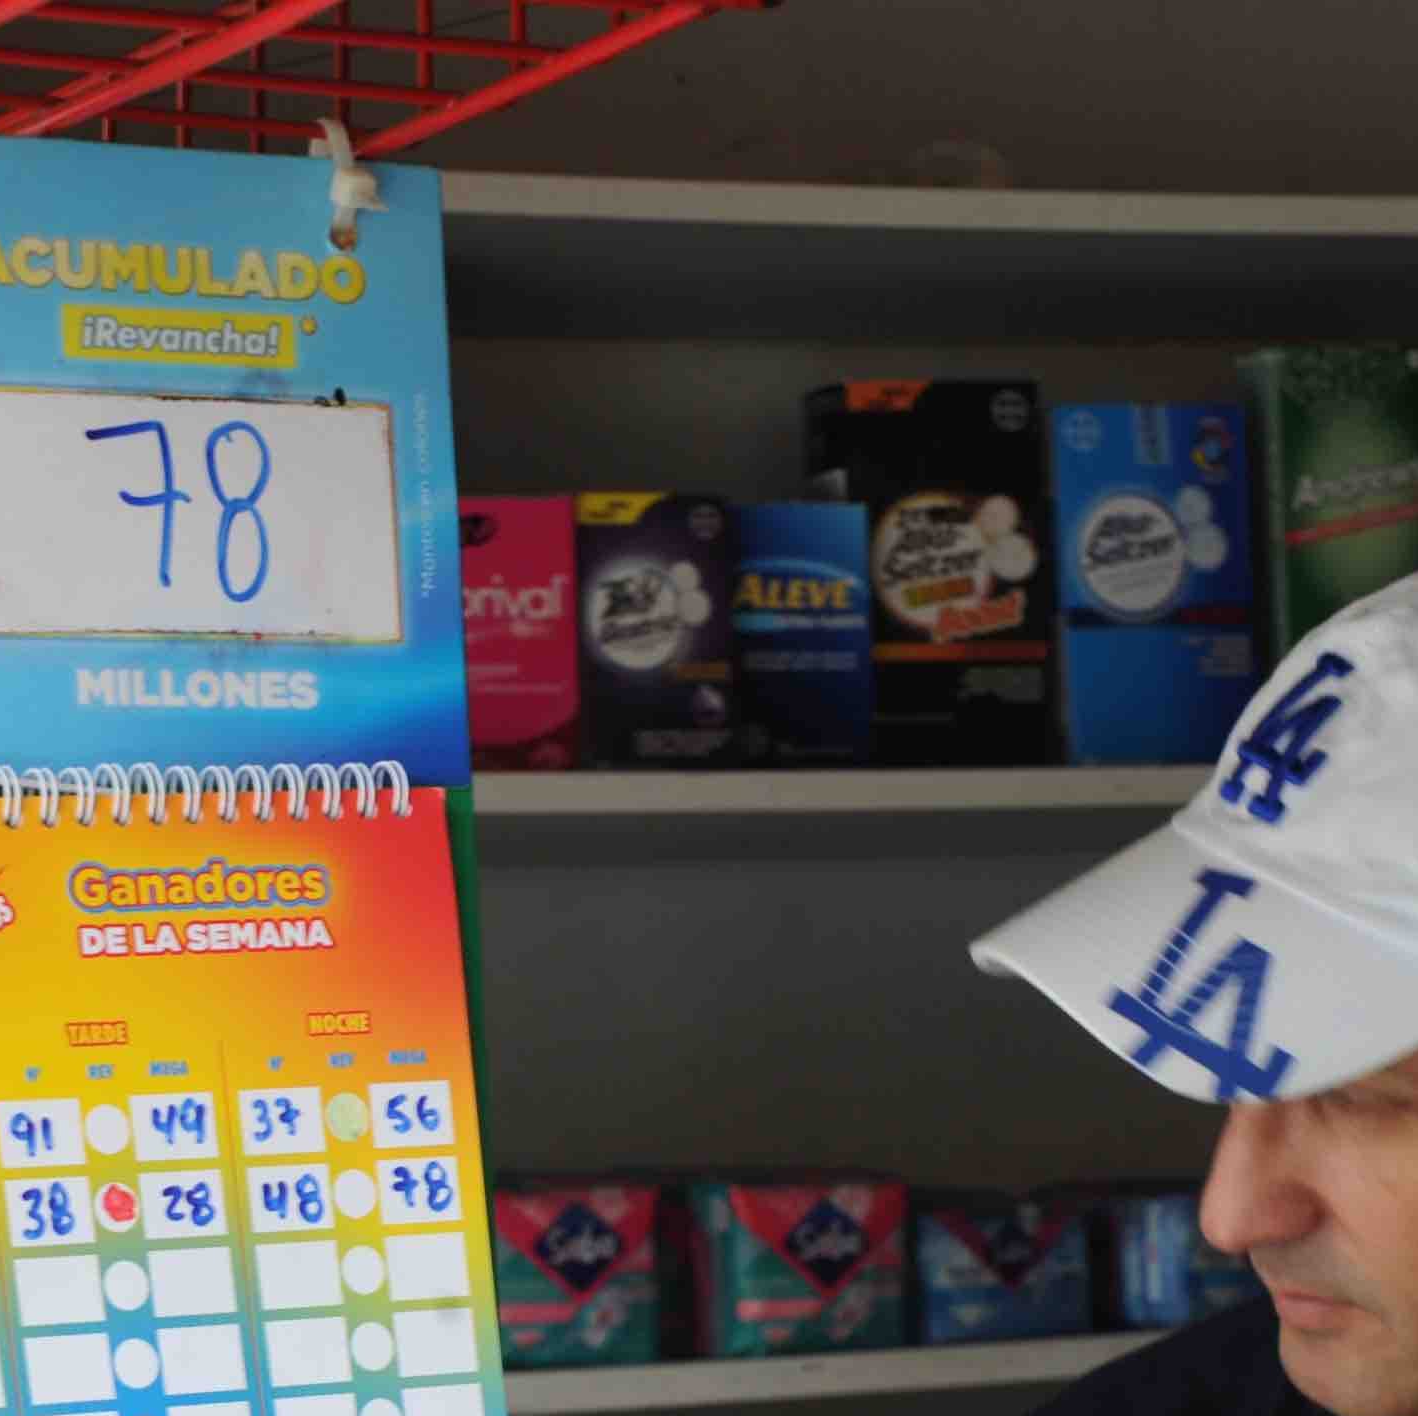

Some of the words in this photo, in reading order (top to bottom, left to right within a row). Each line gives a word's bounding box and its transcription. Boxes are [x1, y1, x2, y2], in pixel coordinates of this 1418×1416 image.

[81, 314, 281, 357] ¡Revancha!
[86, 421, 270, 603] 78
[738, 571, 854, 609] ALEVE
[76, 668, 318, 709] MILLONES
[1219, 652, 1354, 823] LA
[70, 858, 329, 911] Ganadores
[79, 926, 128, 957] DE
[133, 923, 181, 953] LA
[186, 918, 332, 951] SEMANA
[1103, 868, 1298, 1101] LA
[67, 1021, 128, 1046] TARDE
[308, 1010, 371, 1036] NOCHE
[10, 1112, 56, 1159] 91
[151, 1096, 207, 1145] 49
[251, 1095, 302, 1142] 37
[384, 1093, 439, 1133] 56
[21, 1182, 78, 1240] 38
[163, 1181, 216, 1226] 28
[262, 1181, 326, 1224] 48
[394, 1162, 454, 1214] 78
